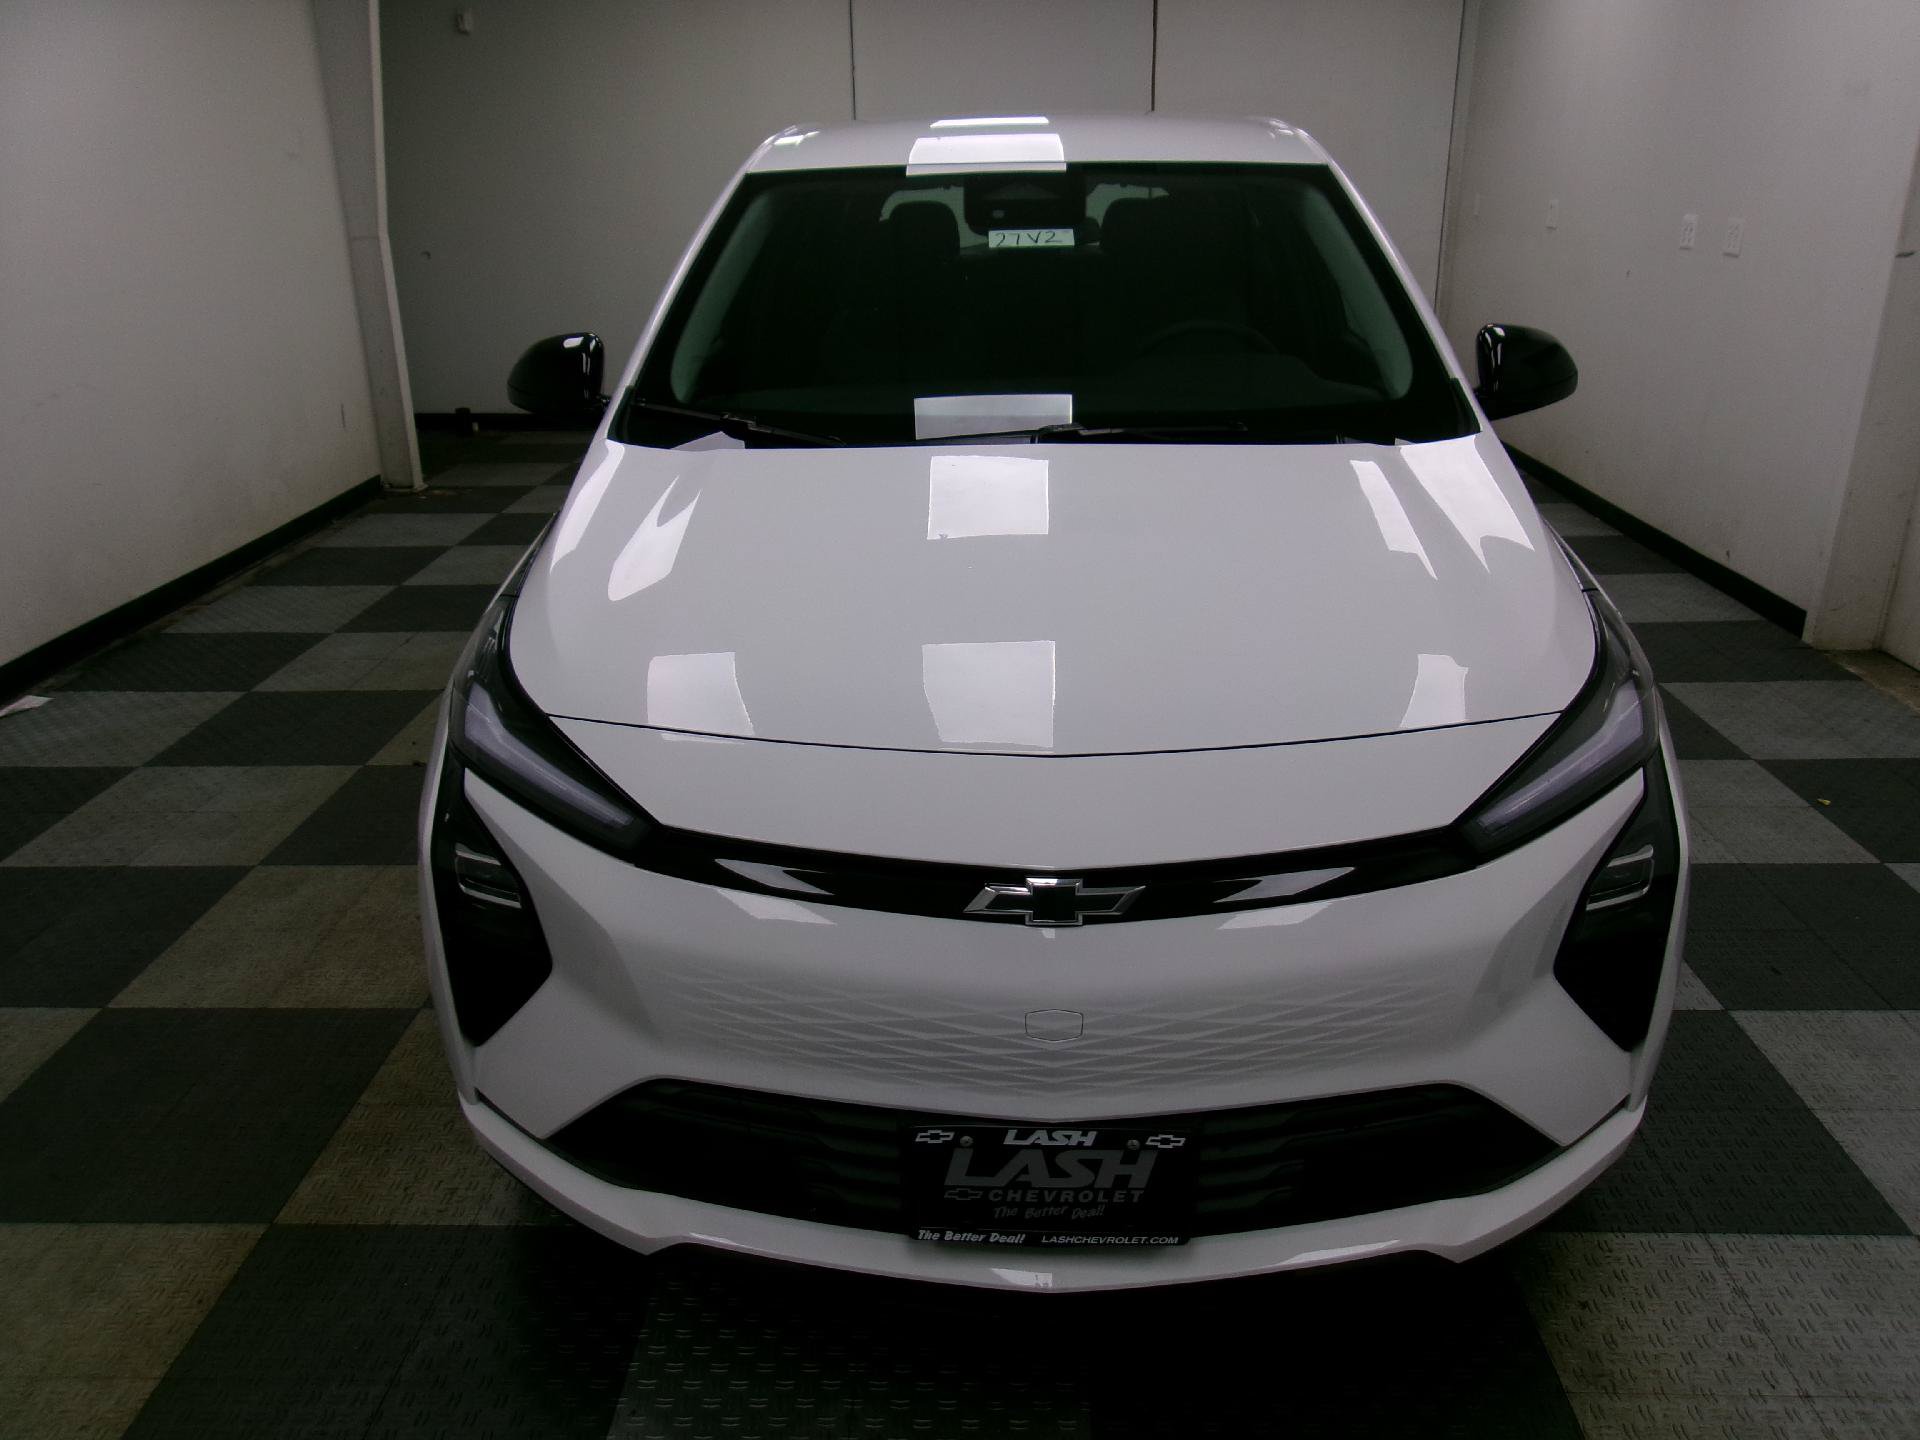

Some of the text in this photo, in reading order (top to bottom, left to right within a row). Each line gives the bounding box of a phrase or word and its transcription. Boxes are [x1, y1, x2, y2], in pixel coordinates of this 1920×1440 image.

[1003, 1129, 1097, 1146] LASH
[944, 1147, 1158, 1189] LASH
[988, 1189, 1145, 1203] CHEVROLET
[993, 1205, 1106, 1220] The Better Deal!
[918, 1229, 1026, 1244] The Better Deal!
[1041, 1235, 1179, 1245] LASHCHEVROLET.COM
